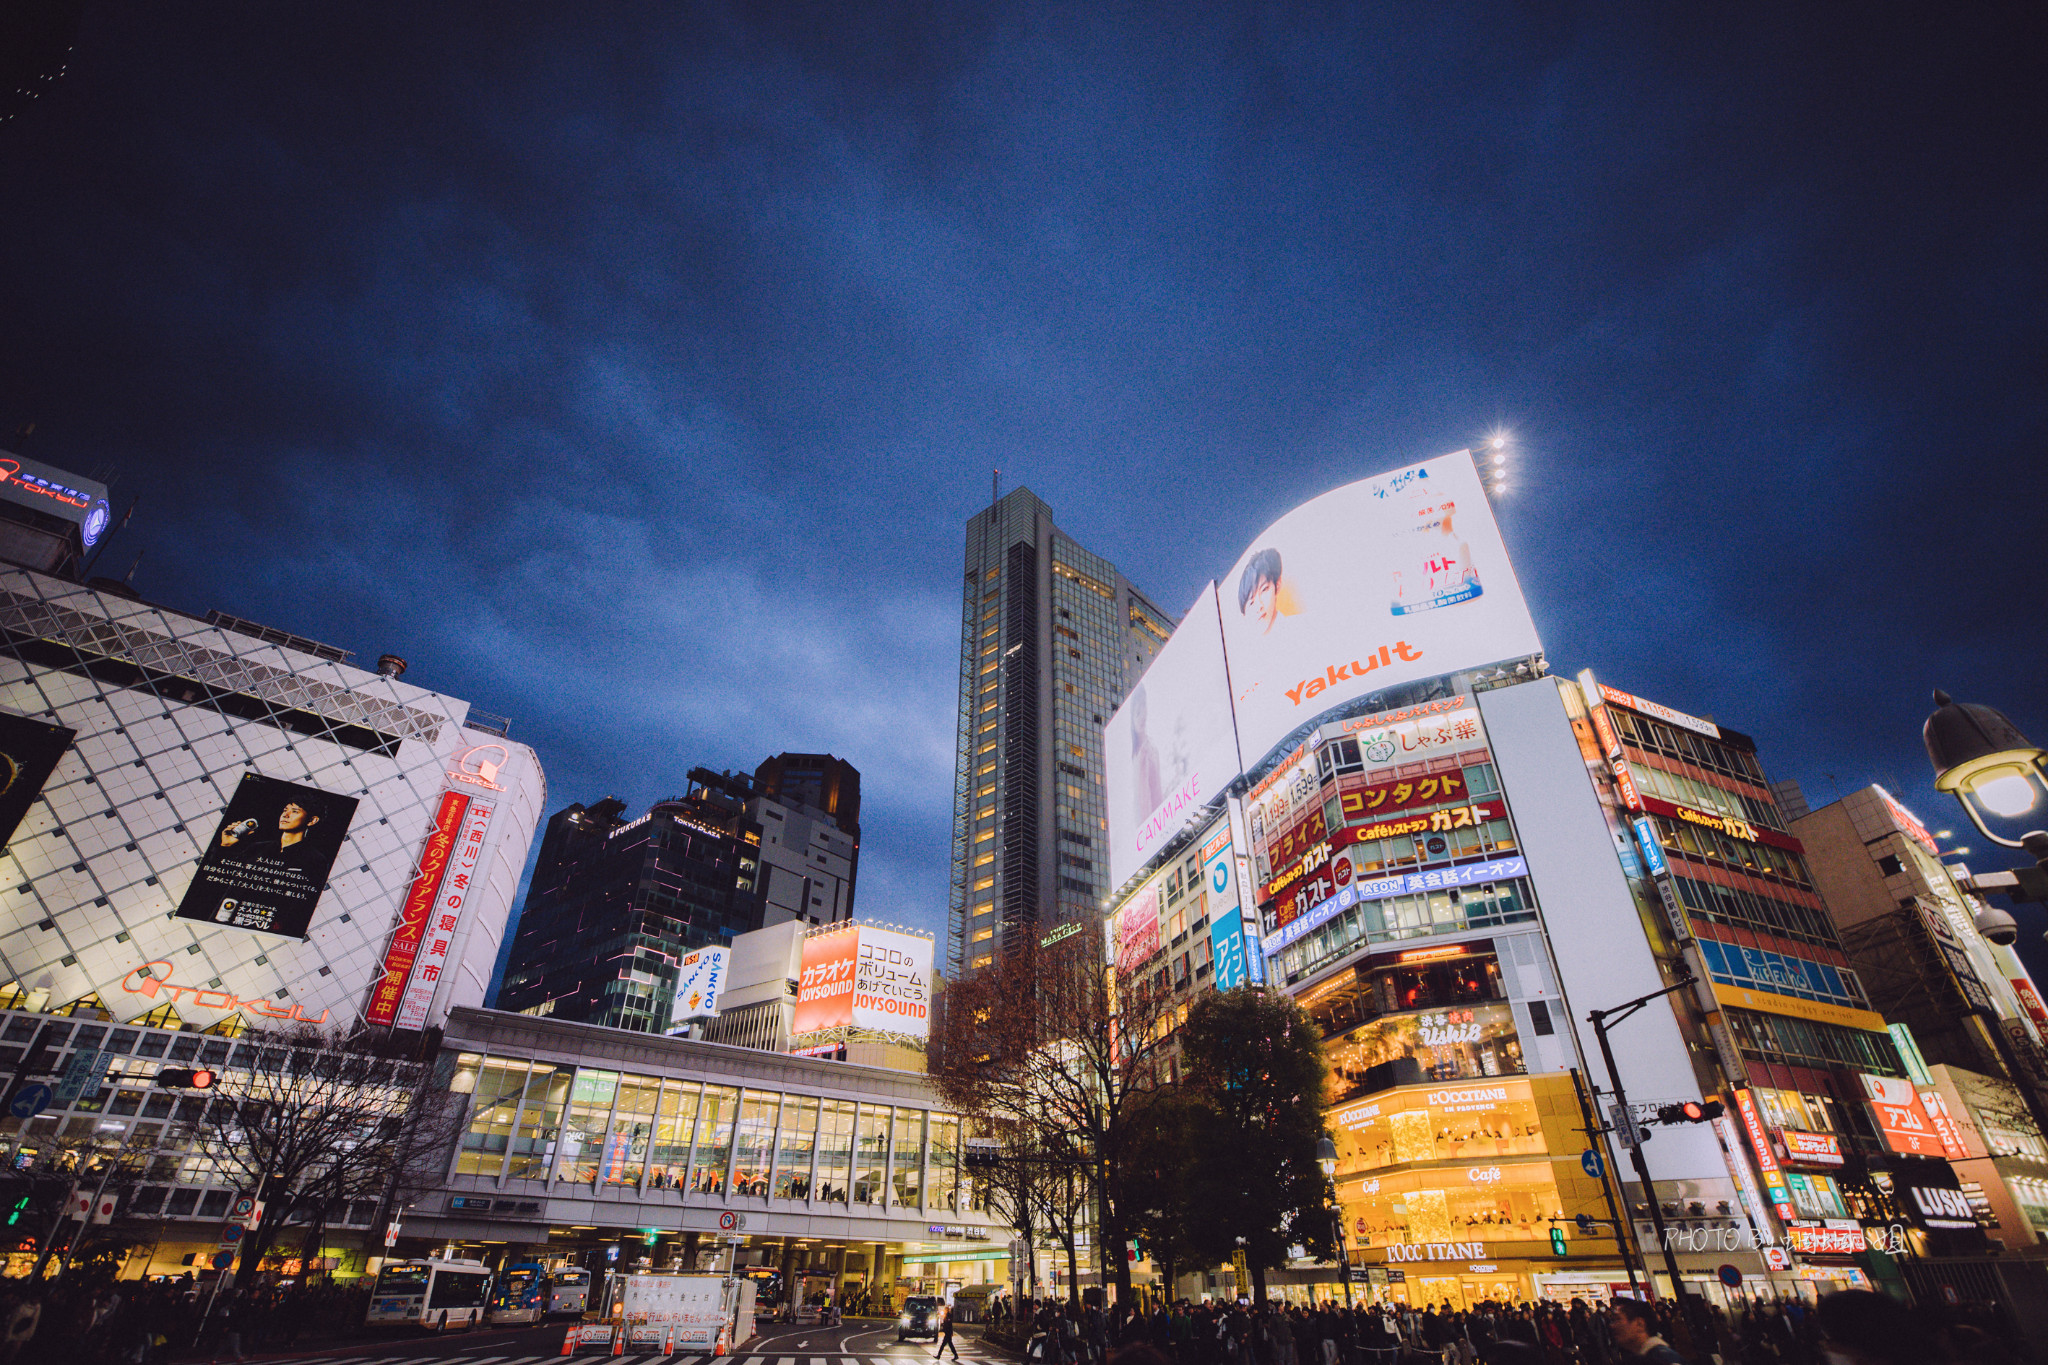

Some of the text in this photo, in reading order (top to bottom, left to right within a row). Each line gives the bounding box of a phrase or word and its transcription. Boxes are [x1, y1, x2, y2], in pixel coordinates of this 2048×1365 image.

[10, 477, 88, 508] TOKYU
[1284, 640, 1424, 706] Yakult
[1342, 696, 1466, 732] しゃぶしゃぶバイキング
[1401, 719, 1477, 751] しゃぶ葉
[448, 770, 507, 792] TOKYU
[1341, 775, 1462, 813] コンタクト
[1136, 772, 1200, 851] CANMAKE
[1430, 804, 1490, 832] ガスト
[1270, 812, 1325, 867] プライス
[1722, 817, 1758, 843] ガスト
[1303, 841, 1333, 875] ガスト
[400, 833, 450, 940] 冬のクリアランス
[1363, 881, 1400, 896] AEON
[1408, 861, 1521, 890] 英会話イーオン
[1295, 877, 1331, 917] ガスト
[232, 916, 270, 930] 黒ラベル
[1264, 912, 1277, 932] 7F
[1285, 899, 1337, 941] 英会話イーオン
[392, 942, 417, 953] SALE
[860, 944, 913, 967] ココロの
[677, 955, 710, 1000] SANKYO
[705, 953, 722, 1009] SANKYO
[801, 958, 854, 987] カラオケ
[859, 961, 927, 988] ボリューム、
[162, 984, 329, 1024] TOKYU
[375, 970, 403, 1015] 開催中
[799, 979, 853, 1002] JOYSOUND
[857, 979, 927, 1002] あげていこう。
[854, 993, 926, 1018] JOYSOUND
[1421, 1009, 1475, 1027] 渋谷 焼肉
[1428, 1088, 1507, 1105] L'OCCITANE
[1457, 1104, 1495, 1112] PROVENCE
[1339, 1104, 1380, 1125] L'OCCITANE
[1883, 1106, 1923, 1131] アコム
[1908, 1137, 1920, 1150] 3F
[1934, 1118, 1954, 1145] アコム
[1363, 1179, 1380, 1195] Café
[1469, 1168, 1501, 1184] Café
[1911, 1187, 1973, 1218] LUSH
[966, 1226, 987, 1235] 渋谷駅
